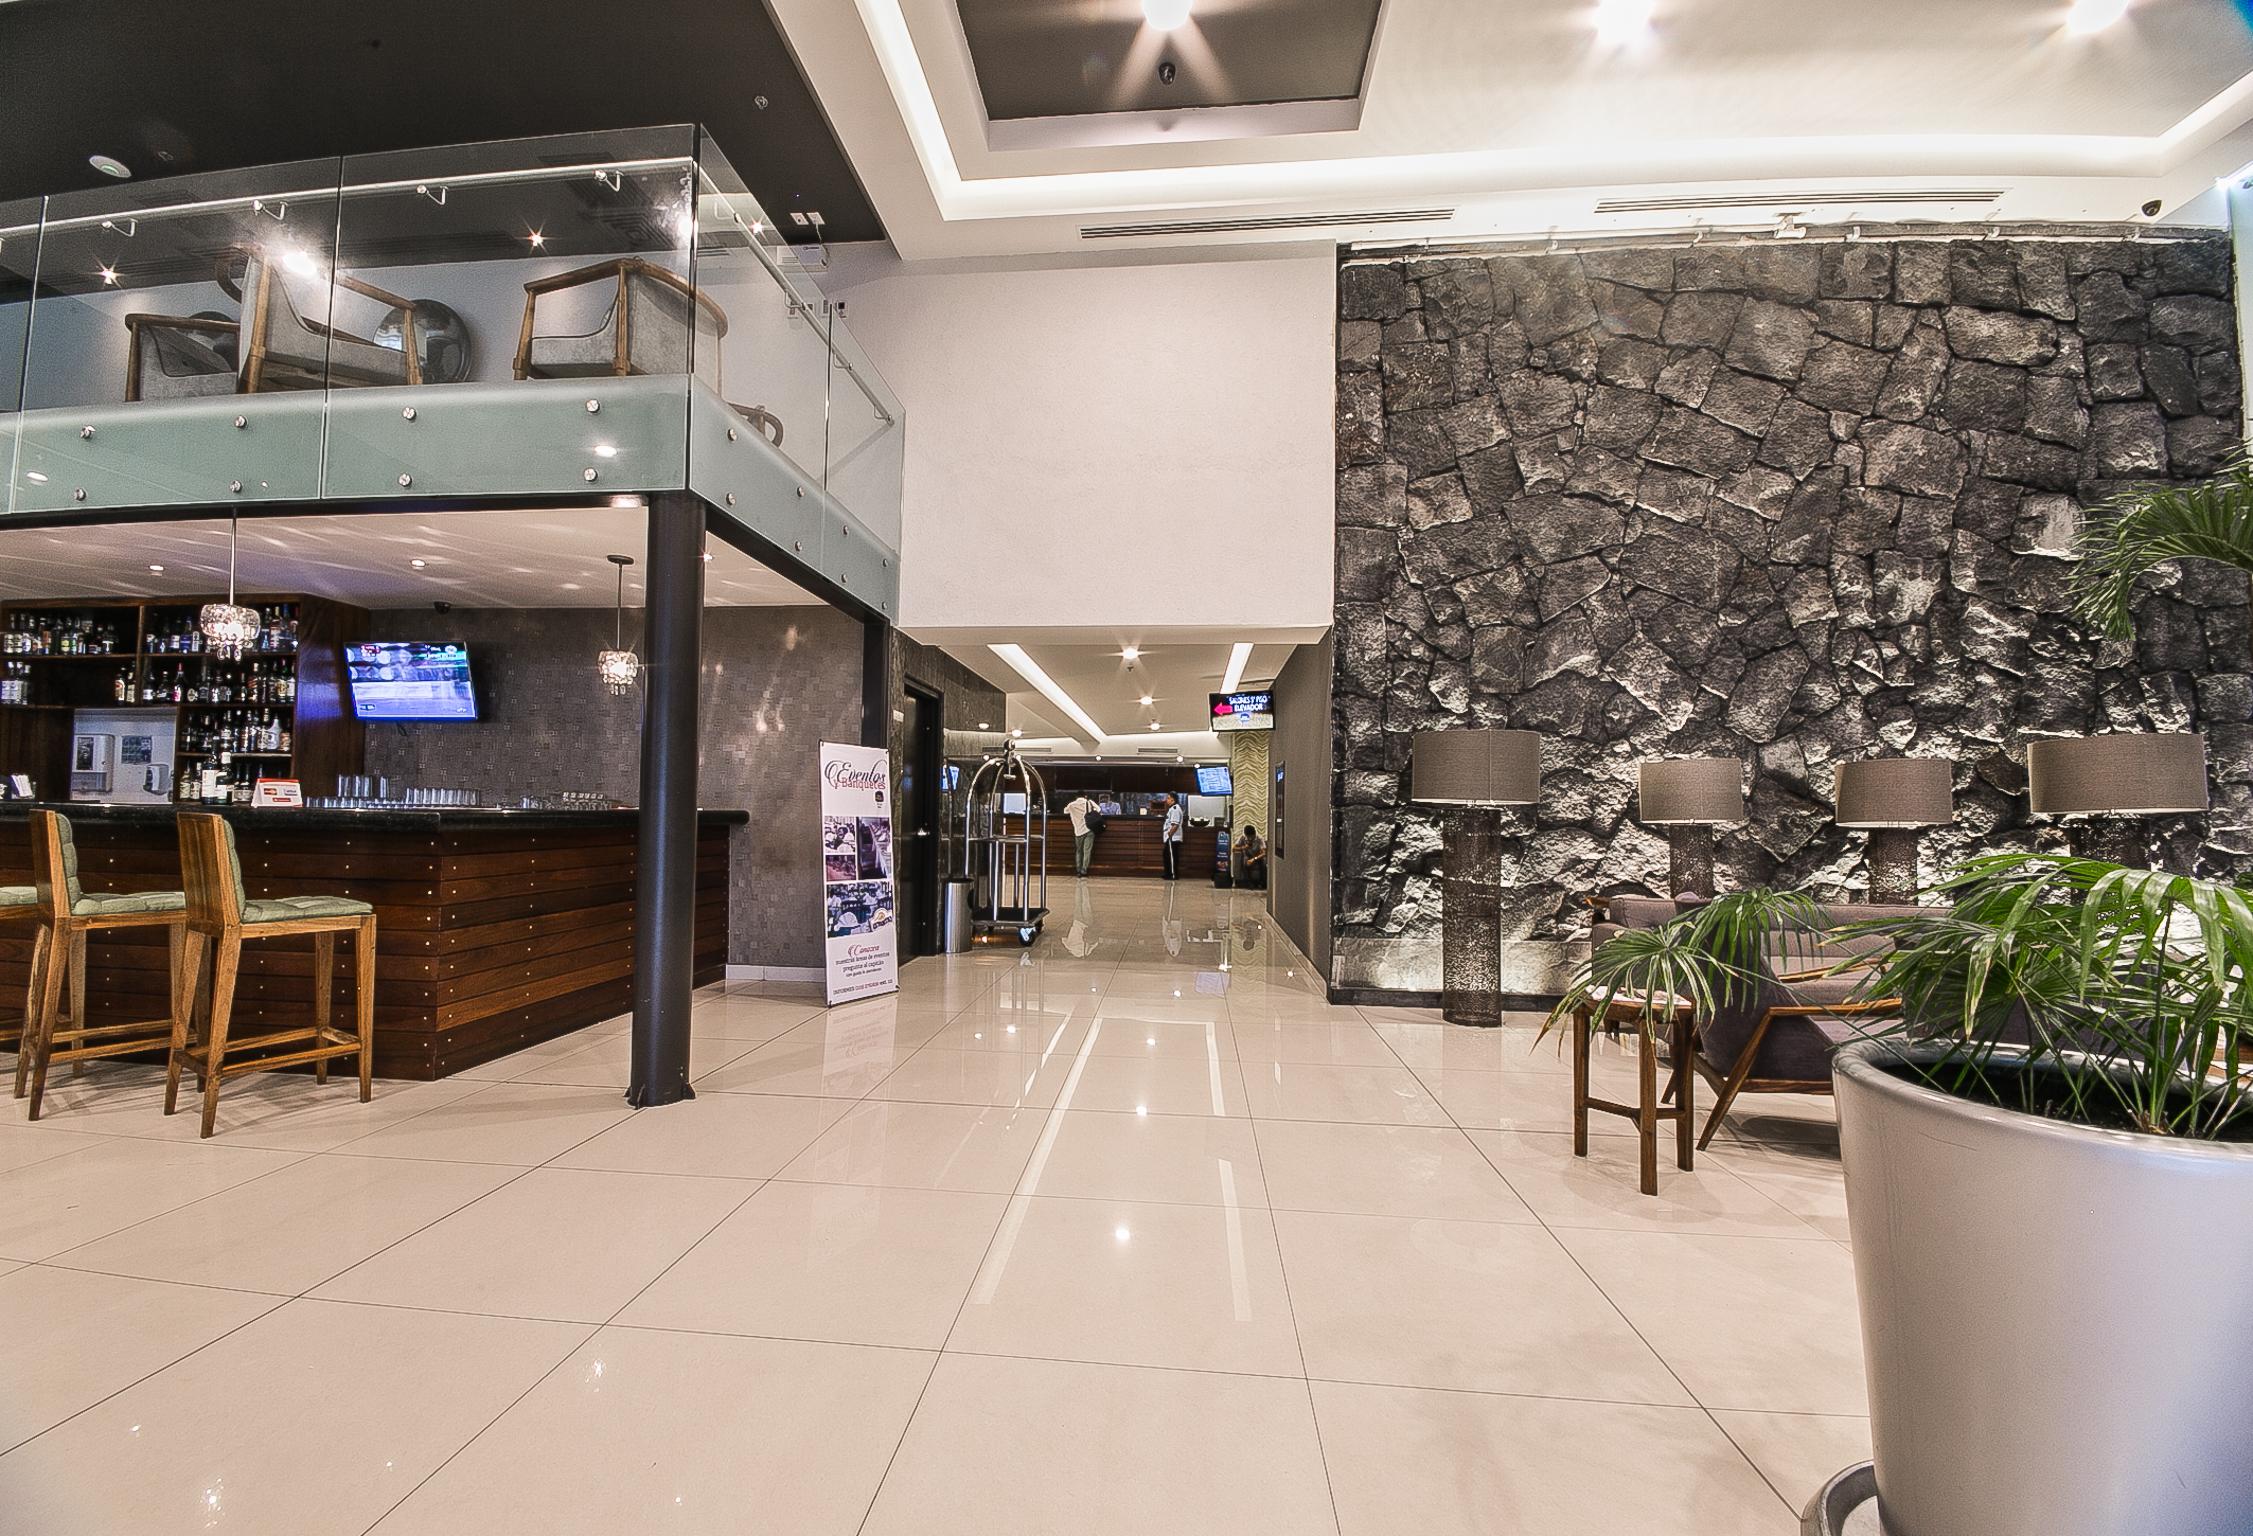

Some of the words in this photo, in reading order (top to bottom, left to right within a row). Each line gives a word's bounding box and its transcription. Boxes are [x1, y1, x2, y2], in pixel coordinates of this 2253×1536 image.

[1234, 704, 1263, 712] ELEVADOR
[824, 760, 887, 787] Eventos
[842, 777, 886, 791] Banquetes
